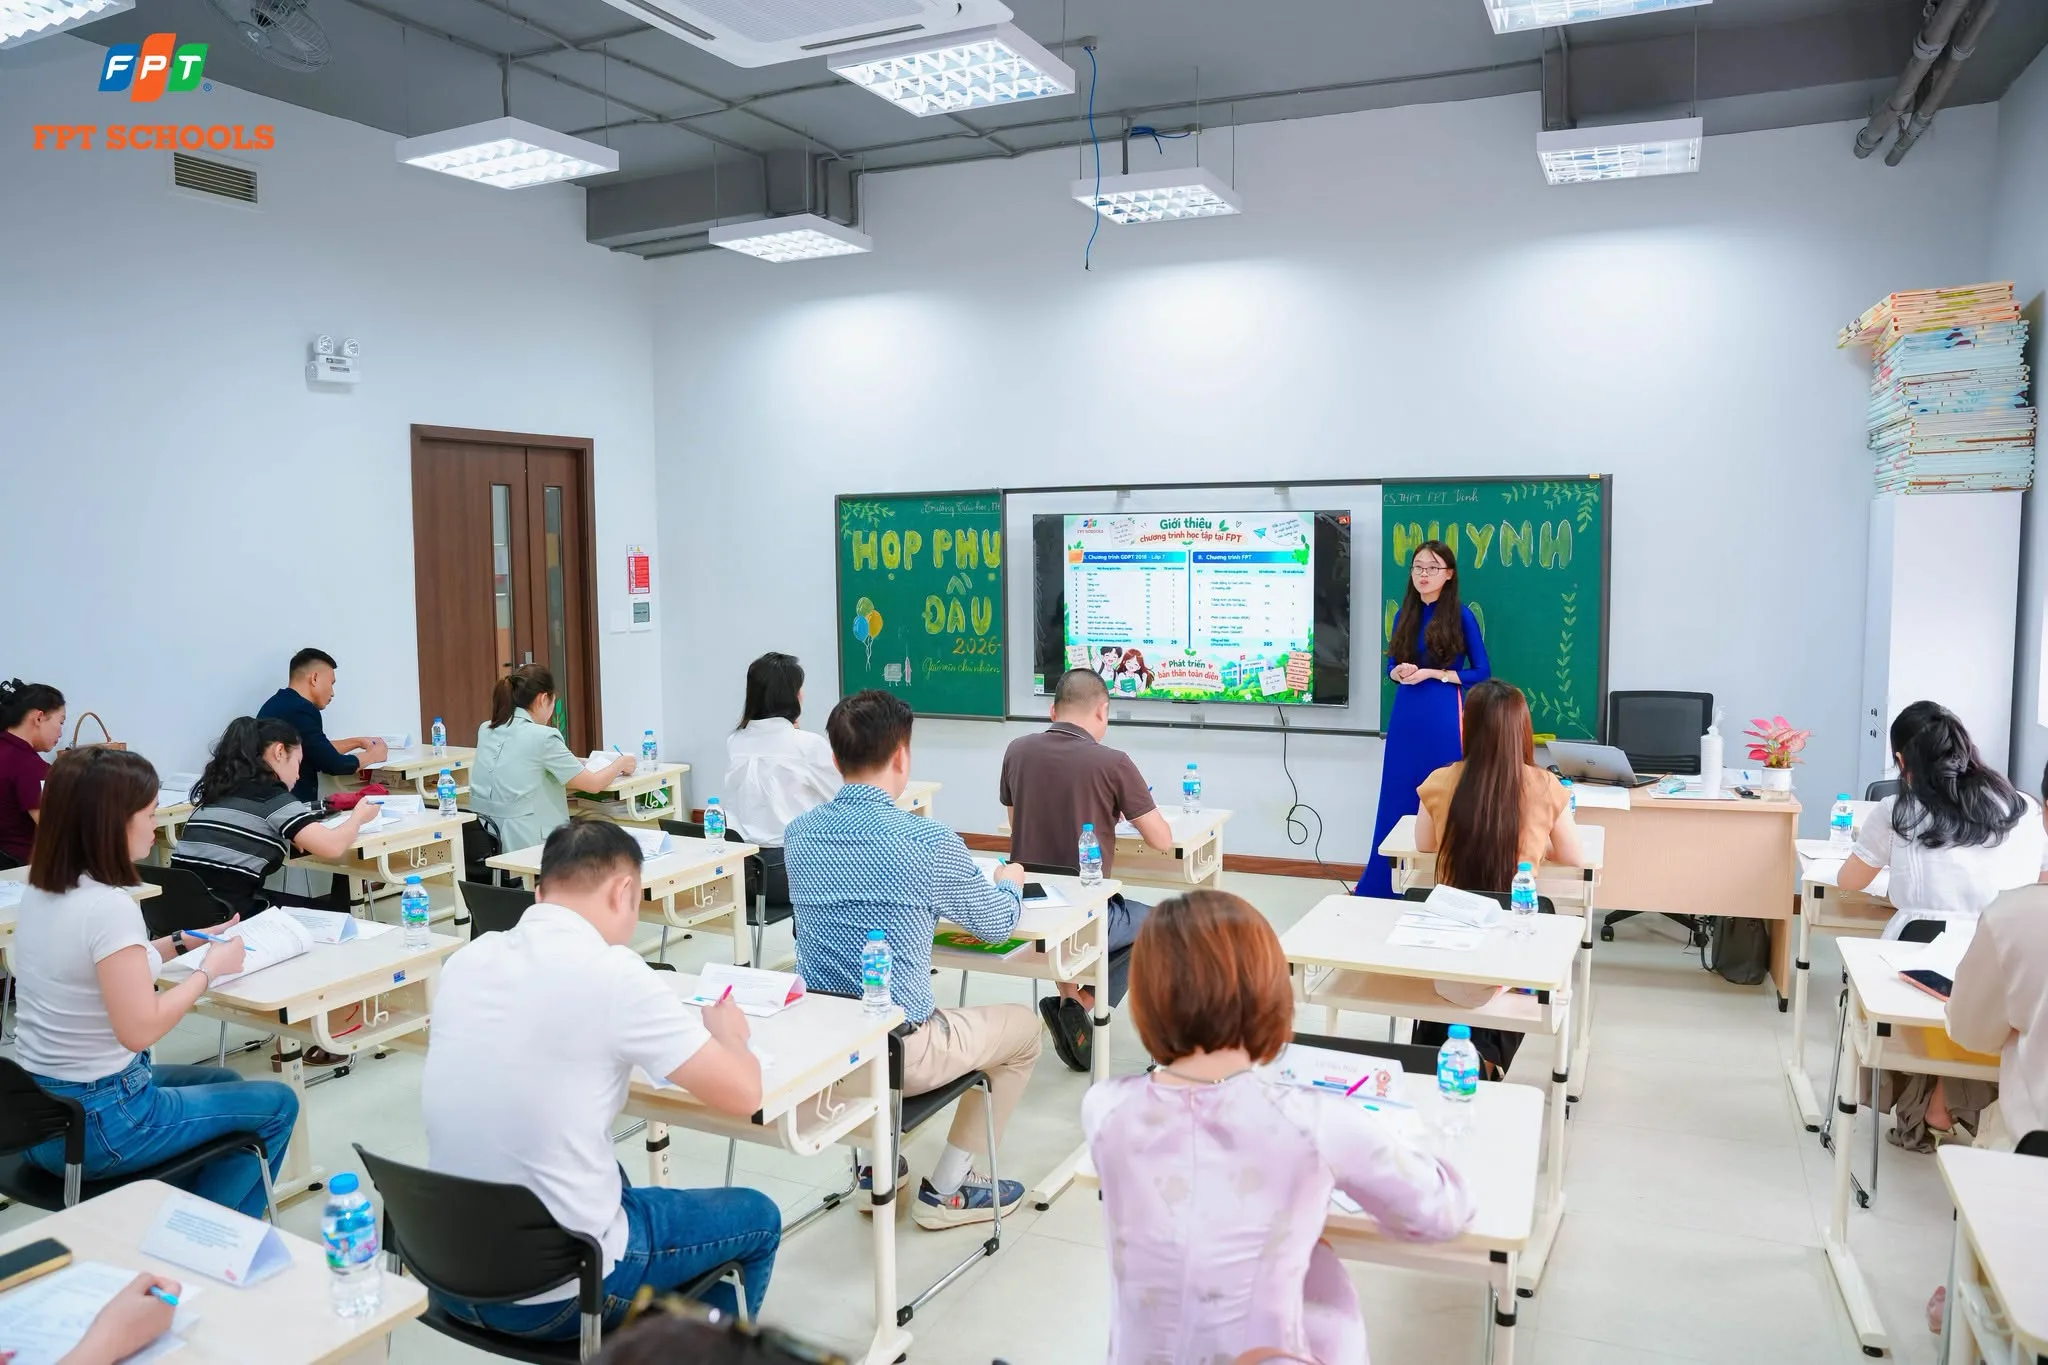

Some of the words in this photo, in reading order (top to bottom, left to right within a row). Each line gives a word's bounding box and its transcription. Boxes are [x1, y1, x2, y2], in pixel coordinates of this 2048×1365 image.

[1400, 493, 1421, 504] THPT
[1455, 488, 1479, 502] Vinh
[1160, 517, 1181, 530] Giới
[1184, 517, 1212, 531] thiệu
[1140, 533, 1167, 543] chương
[1168, 530, 1185, 539] trình
[1186, 530, 1199, 540] học
[1201, 531, 1213, 541] tập
[1215, 532, 1224, 542] tại
[1225, 533, 1242, 543] FPT
[852, 529, 922, 581] HỌP
[933, 528, 1001, 582] PHỤ
[1169, 659, 1186, 668] Phát
[1187, 659, 1206, 669] triển
[1158, 670, 1170, 679] bản
[1171, 669, 1187, 677] thân
[1188, 669, 1203, 678] toàn
[1204, 671, 1219, 680] diện
